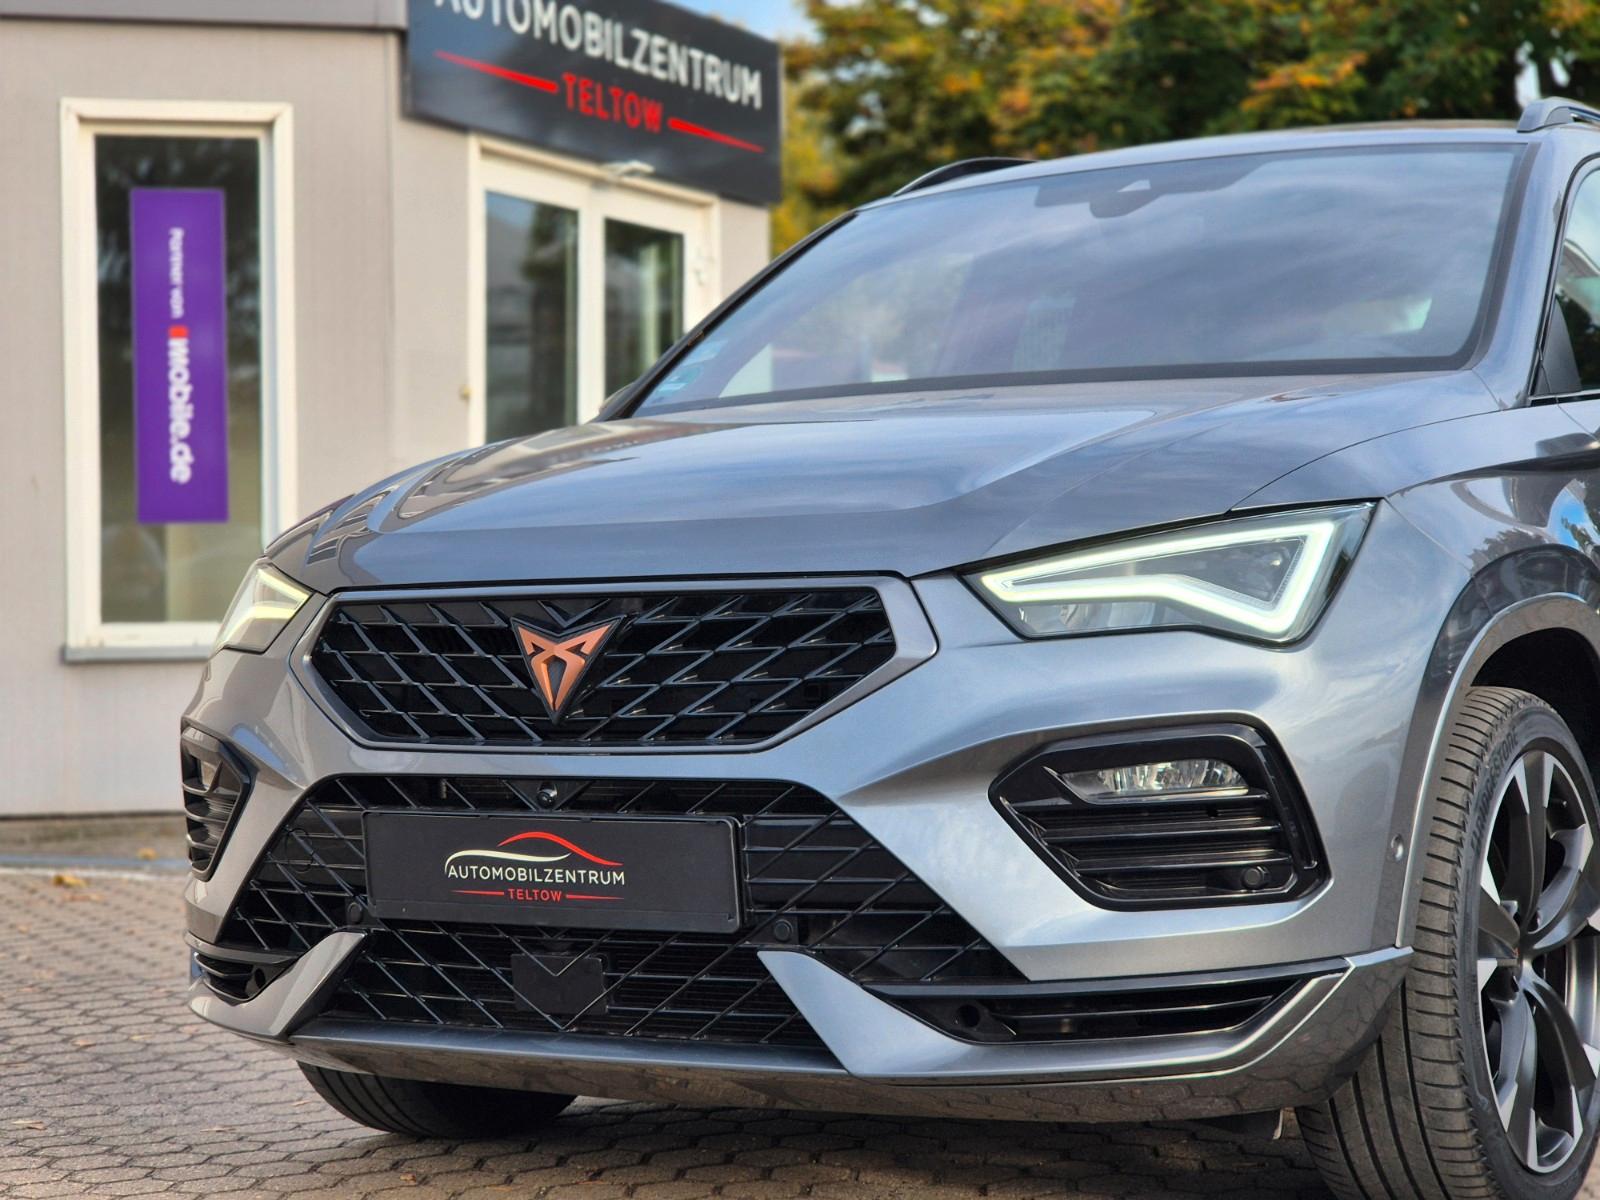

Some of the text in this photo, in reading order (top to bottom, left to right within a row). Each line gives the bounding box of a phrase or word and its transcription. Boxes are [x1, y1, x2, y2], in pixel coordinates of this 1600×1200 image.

[434, 0, 763, 109] TOMOBILZENTRUM
[562, 73, 664, 132] TELTOW
[167, 227, 195, 485] Partner von mobile.de
[447, 865, 626, 886] AUTOMOBILZENTRUM
[507, 888, 563, 903] TELTOW
